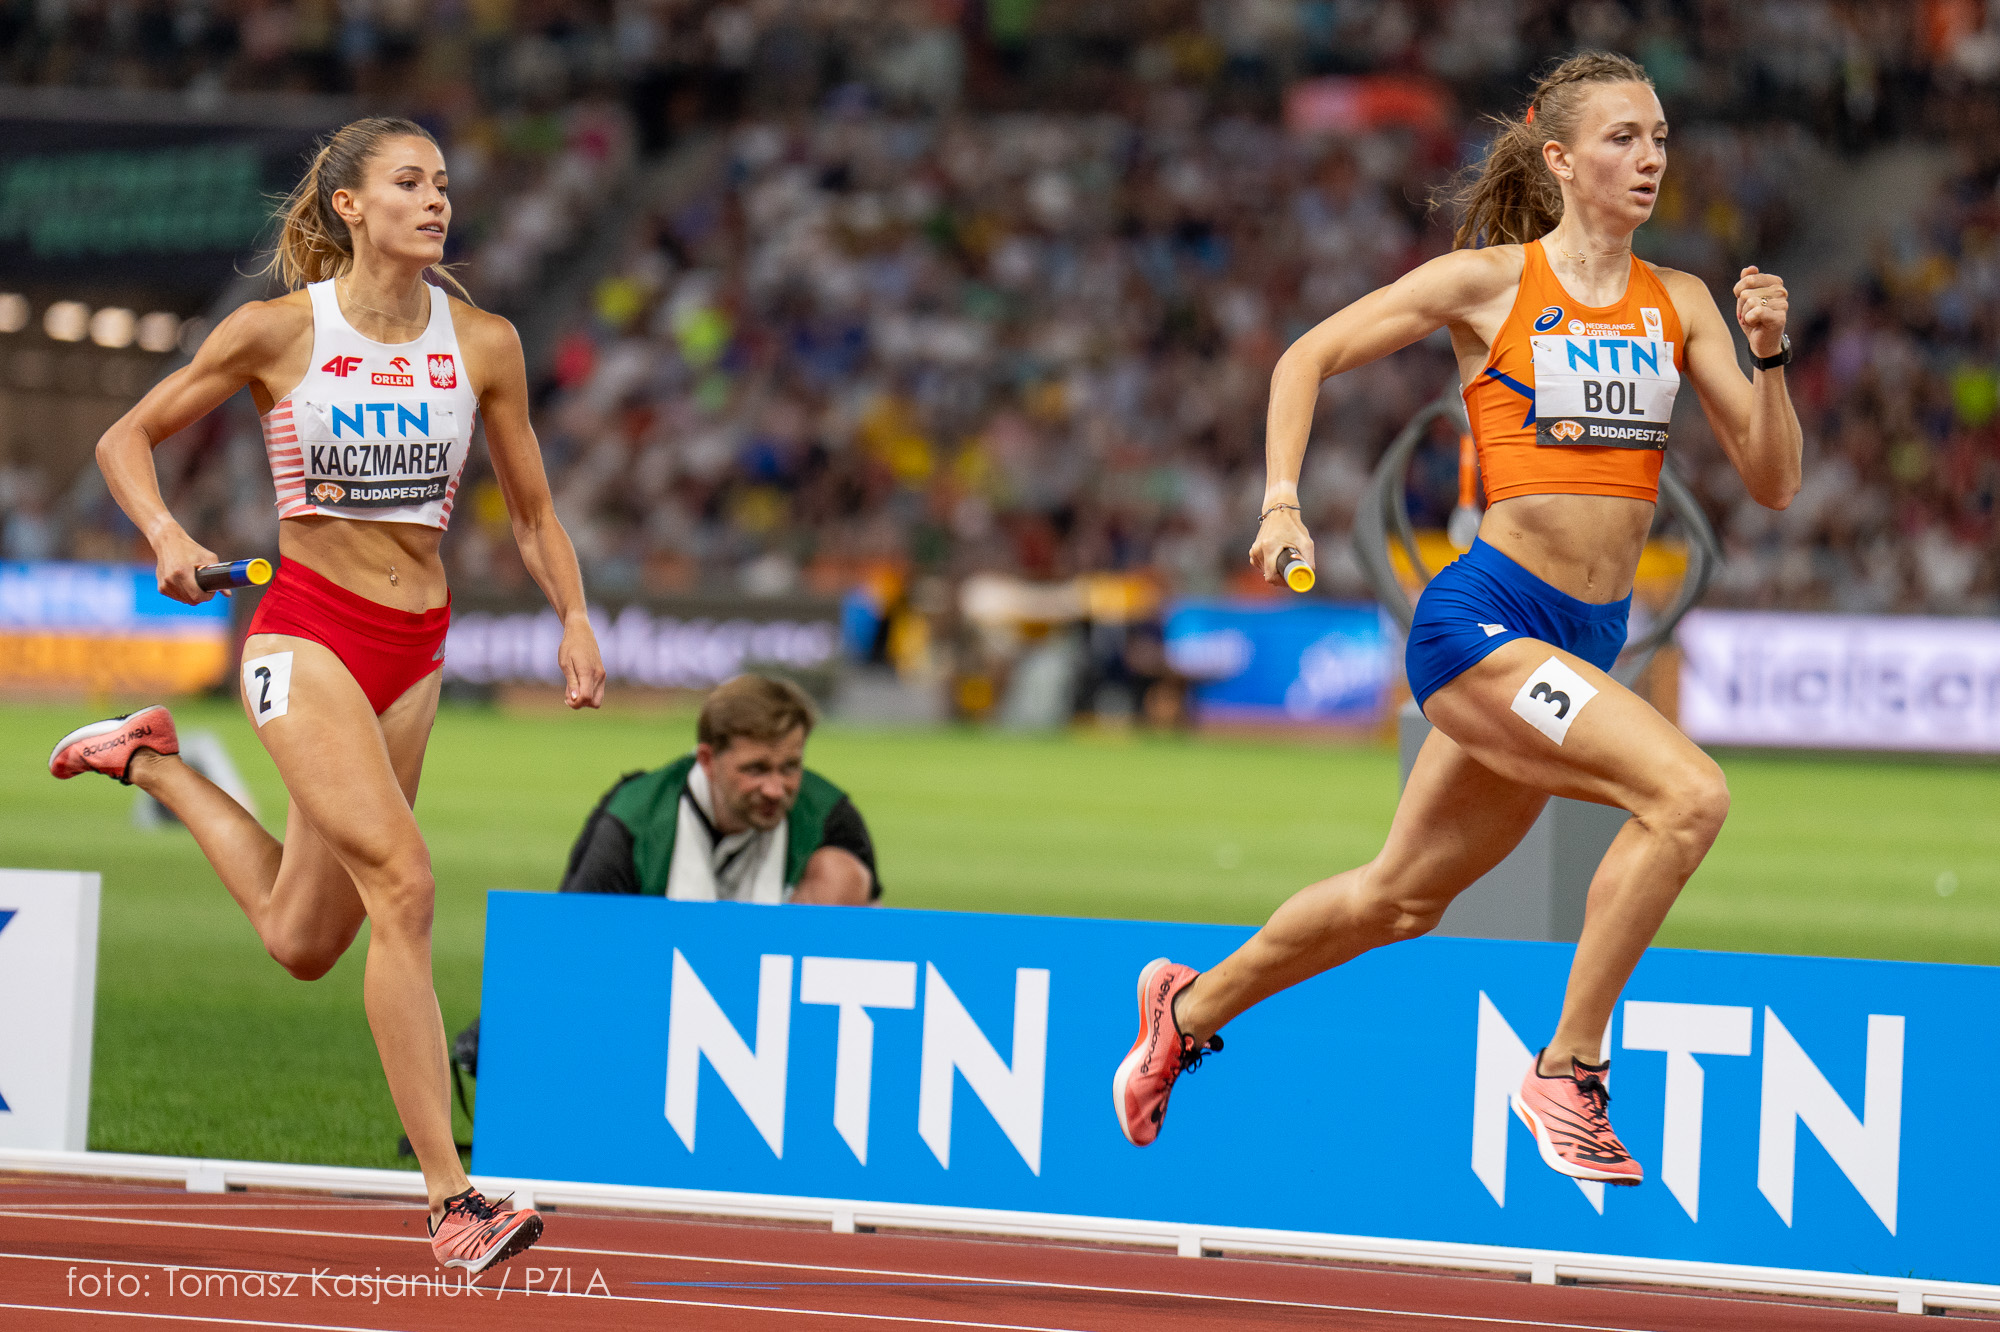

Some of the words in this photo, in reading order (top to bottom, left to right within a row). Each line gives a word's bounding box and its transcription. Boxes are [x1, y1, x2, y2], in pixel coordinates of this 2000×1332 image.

[1586, 322, 1636, 330] NEDERLANDSE
[321, 355, 363, 377] 4F
[1565, 338, 1660, 376] NTN
[373, 374, 411, 386] ORLEN
[1583, 380, 1645, 415] BOL
[331, 402, 429, 439] NTN
[310, 442, 452, 477] KACZMAREK
[254, 666, 272, 714] 2
[1529, 681, 1571, 720] 3
[83, 735, 126, 757] balance
[128, 724, 152, 742] new
[1157, 972, 1175, 1007] new
[1140, 1008, 1164, 1074] balance
[664, 946, 1051, 1177] NTN
[1471, 989, 1905, 1237] NTN
